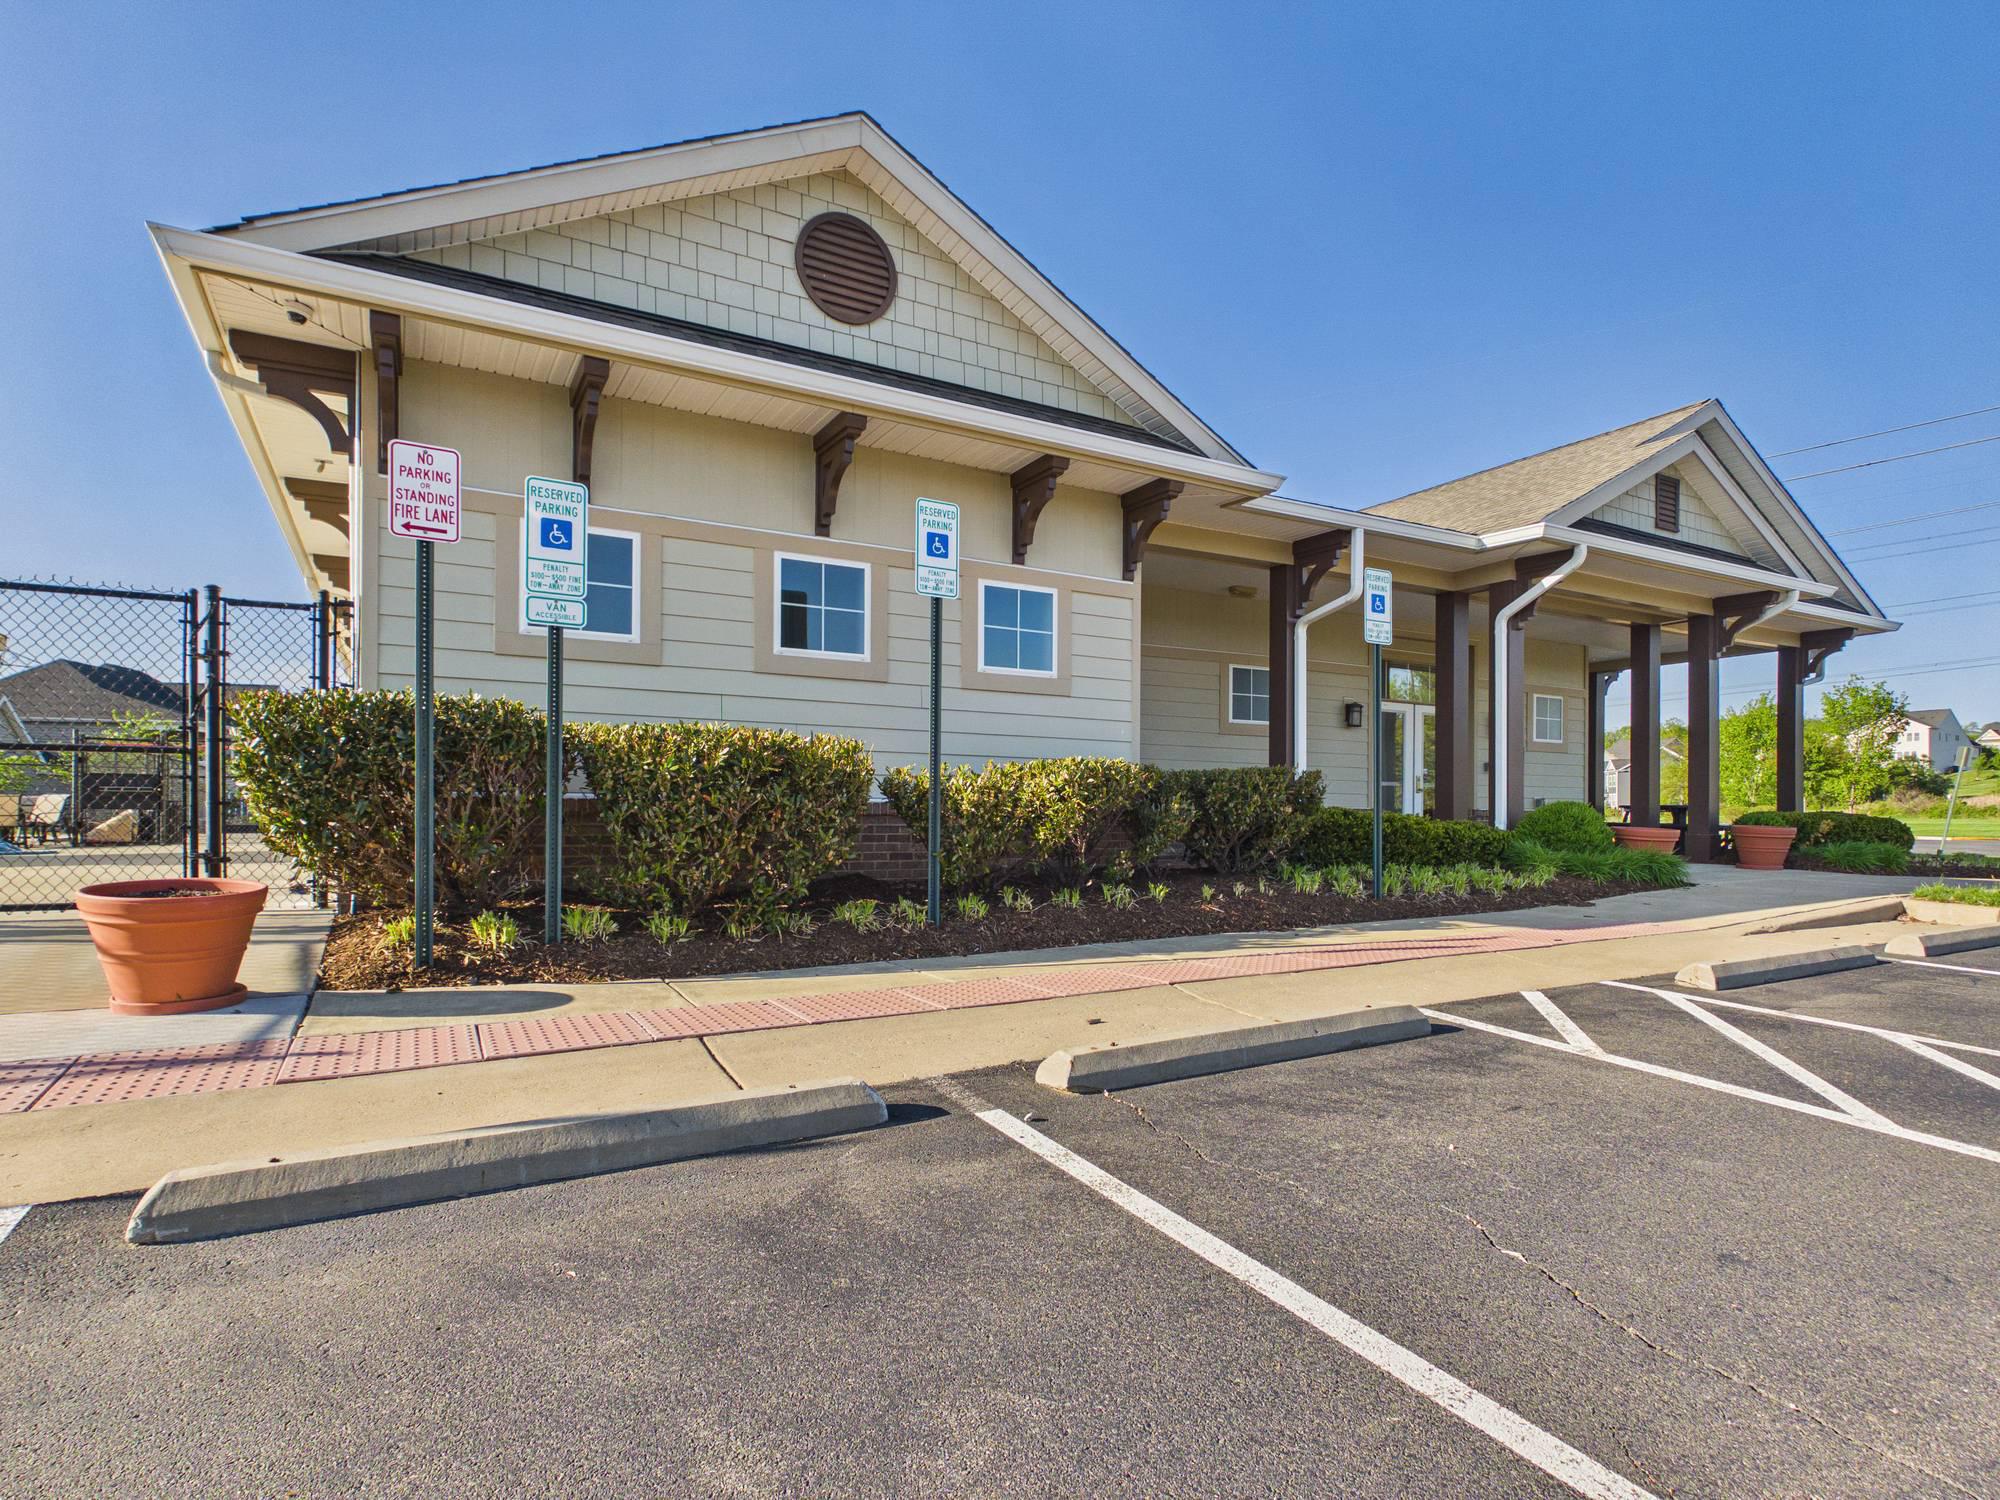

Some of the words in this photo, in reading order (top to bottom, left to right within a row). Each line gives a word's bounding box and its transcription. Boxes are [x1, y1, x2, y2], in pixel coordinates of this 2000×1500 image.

[417, 452, 434, 466] NO
[399, 465, 452, 484] PARKING
[420, 482, 431, 490] OR
[395, 487, 455, 507] STANDING
[530, 485, 583, 504] RESERVED
[395, 503, 420, 520] FIRE
[425, 507, 455, 525] LANE
[535, 501, 578, 518] PARKING
[919, 505, 956, 520] RESERVED
[922, 518, 953, 532] PARKING
[543, 563, 569, 573] PENALTY
[569, 575, 582, 584] FINE
[567, 584, 582, 593] ZONE
[546, 602, 567, 612] VAN
[535, 611, 576, 621] ACCESSIBLE
